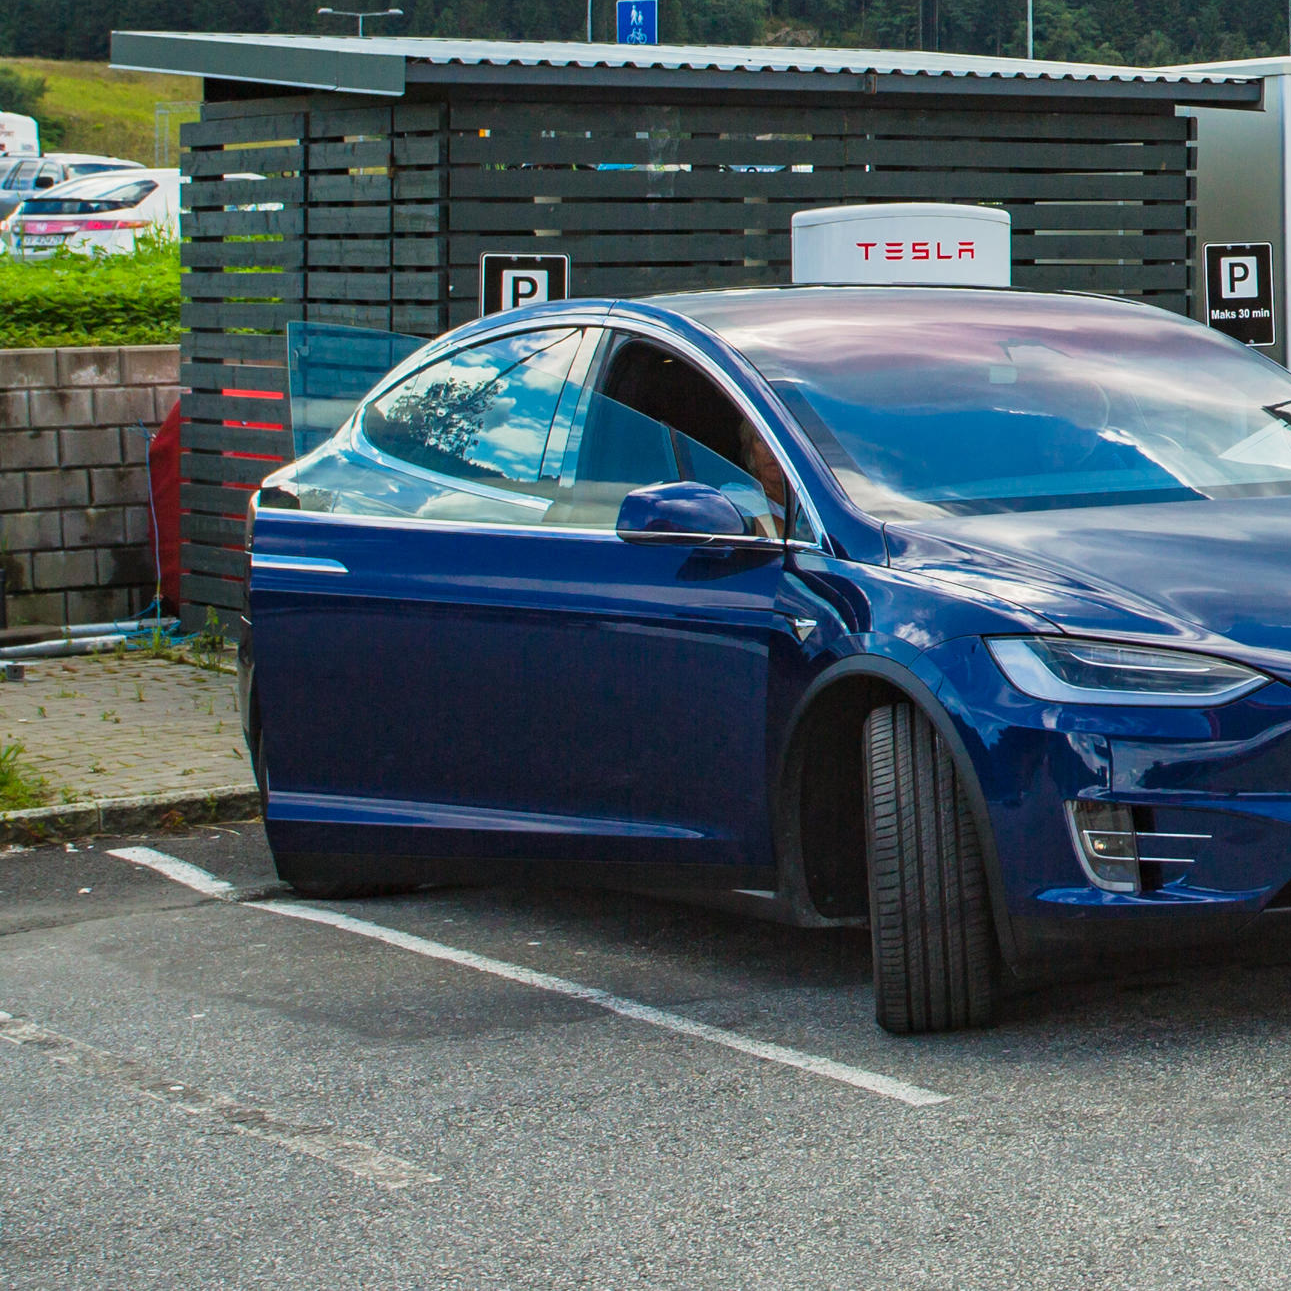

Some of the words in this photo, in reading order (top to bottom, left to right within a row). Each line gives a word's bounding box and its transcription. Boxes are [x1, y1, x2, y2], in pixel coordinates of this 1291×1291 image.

[856, 242, 975, 260] TESLA
[1229, 262, 1249, 293] P
[512, 276, 538, 308] P
[1211, 309, 1236, 320] Maks
[1239, 309, 1250, 318] 30
[1252, 308, 1270, 318] min
